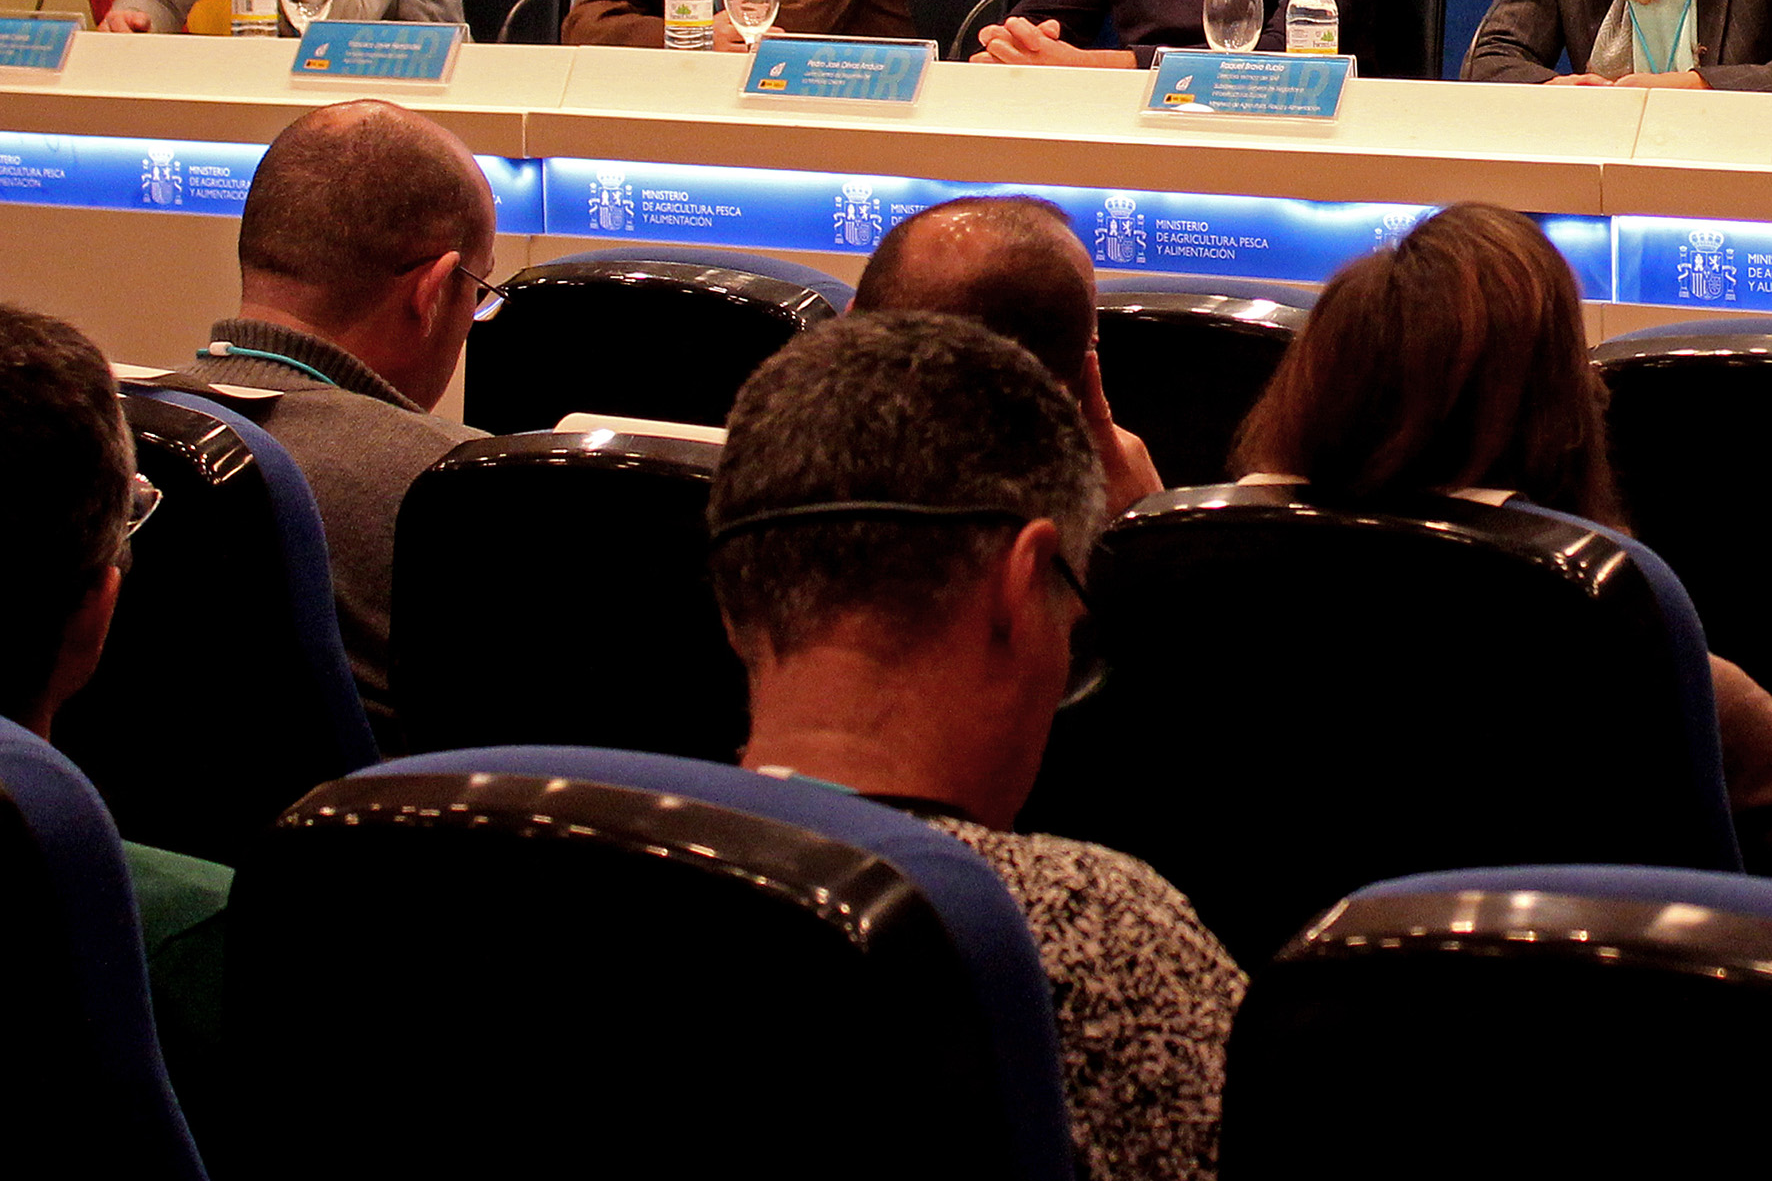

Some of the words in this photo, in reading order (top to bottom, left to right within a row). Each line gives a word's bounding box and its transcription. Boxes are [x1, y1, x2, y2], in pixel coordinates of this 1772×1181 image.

[188, 166, 230, 178] MINISTERIO
[189, 176, 201, 187] DE
[642, 188, 689, 202] MINISTERIO
[642, 202, 654, 213] DE
[655, 202, 715, 216] AGRICULTURA,
[716, 205, 742, 216] PESCA
[642, 214, 649, 224] Y
[649, 214, 713, 227] ALIMENTACIÓN
[1156, 219, 1209, 232] MINISTERIO
[1156, 232, 1168, 243] DE
[1168, 232, 1238, 247] AGRICULTURA,
[1239, 236, 1269, 249] PESCA
[1156, 245, 1163, 255] Y
[1163, 244, 1236, 260] ALIMENTACIÓN
[1748, 267, 1762, 278] DE
[1748, 281, 1755, 292] Y
